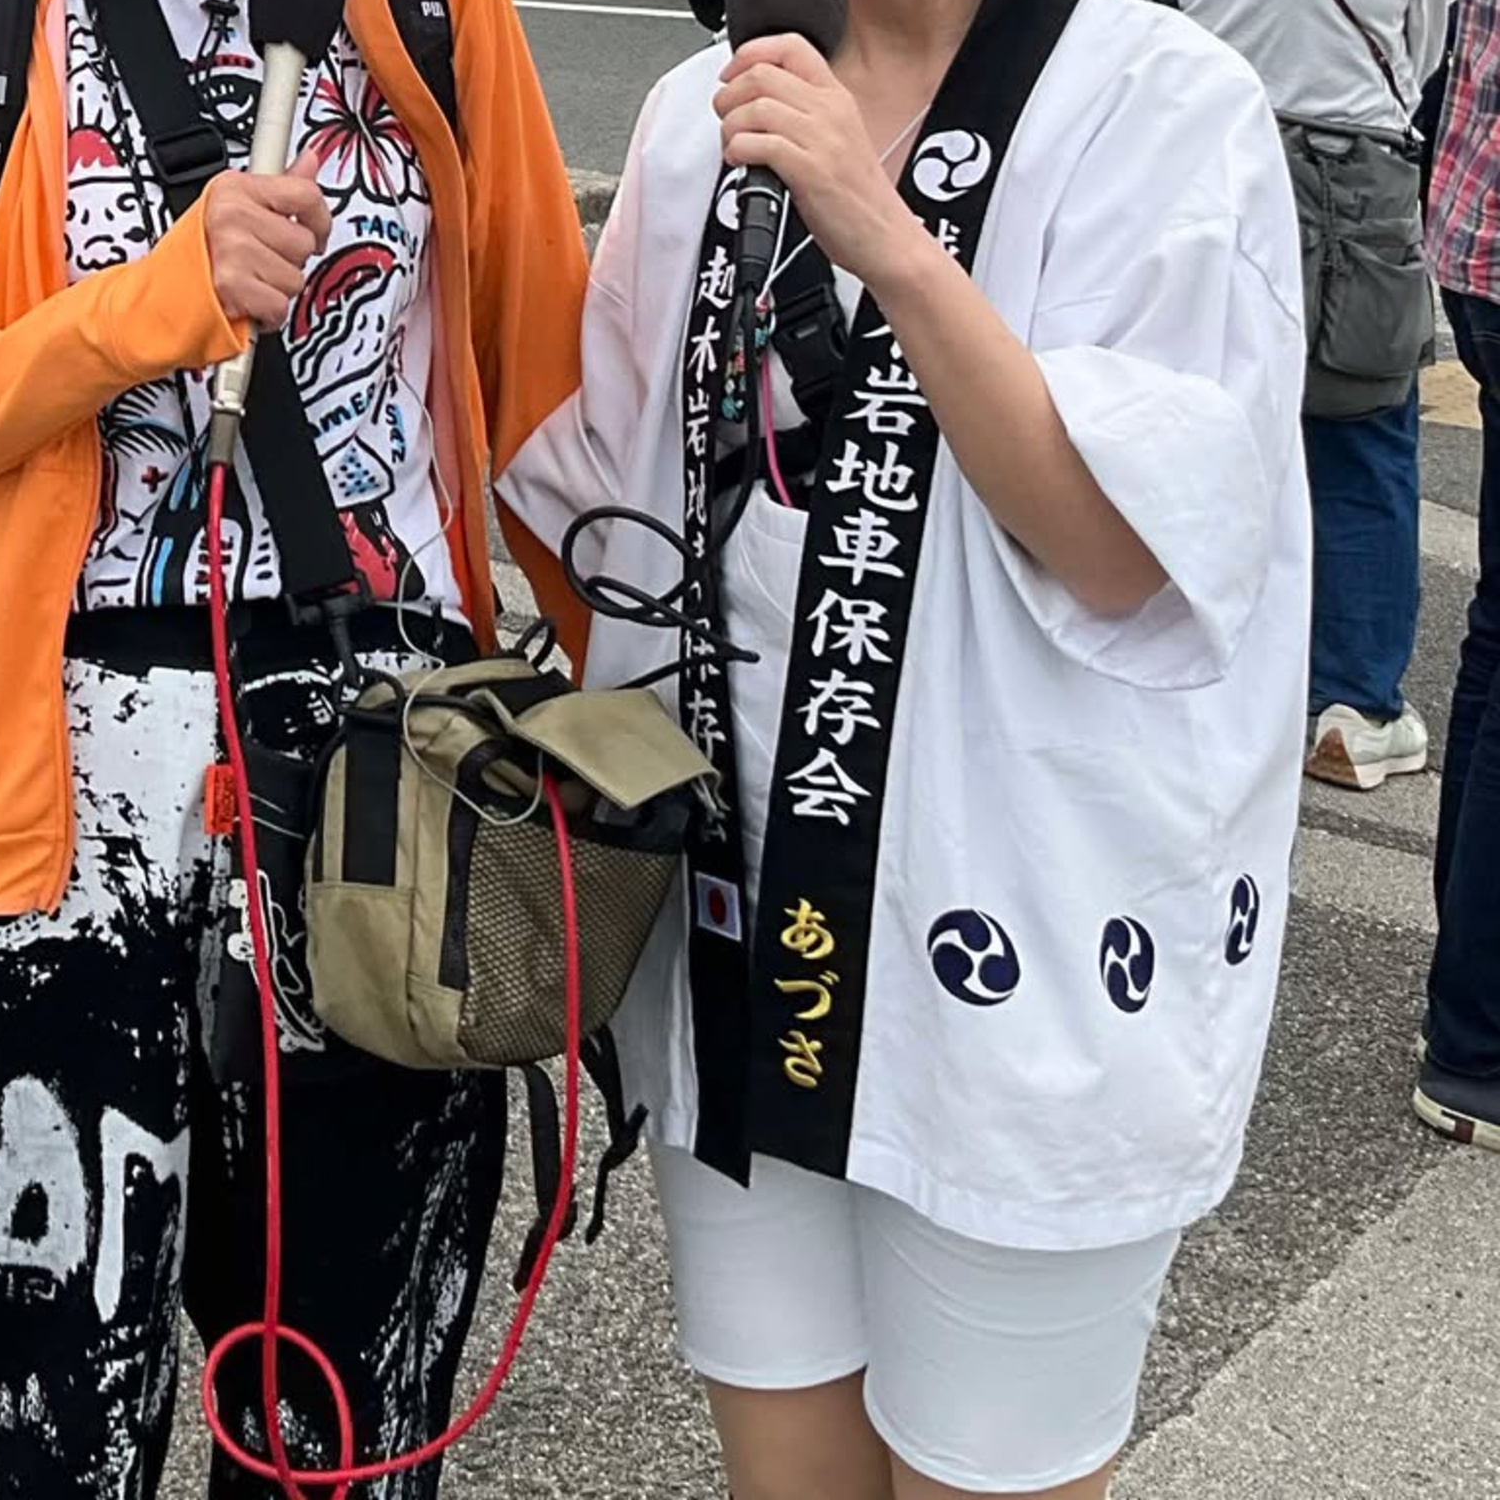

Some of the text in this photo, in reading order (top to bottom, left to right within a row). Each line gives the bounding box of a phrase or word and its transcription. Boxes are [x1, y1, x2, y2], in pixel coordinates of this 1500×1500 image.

[421, 1, 445, 17] PU
[774, 216, 963, 1088] 岩地車保存会 あづさ
